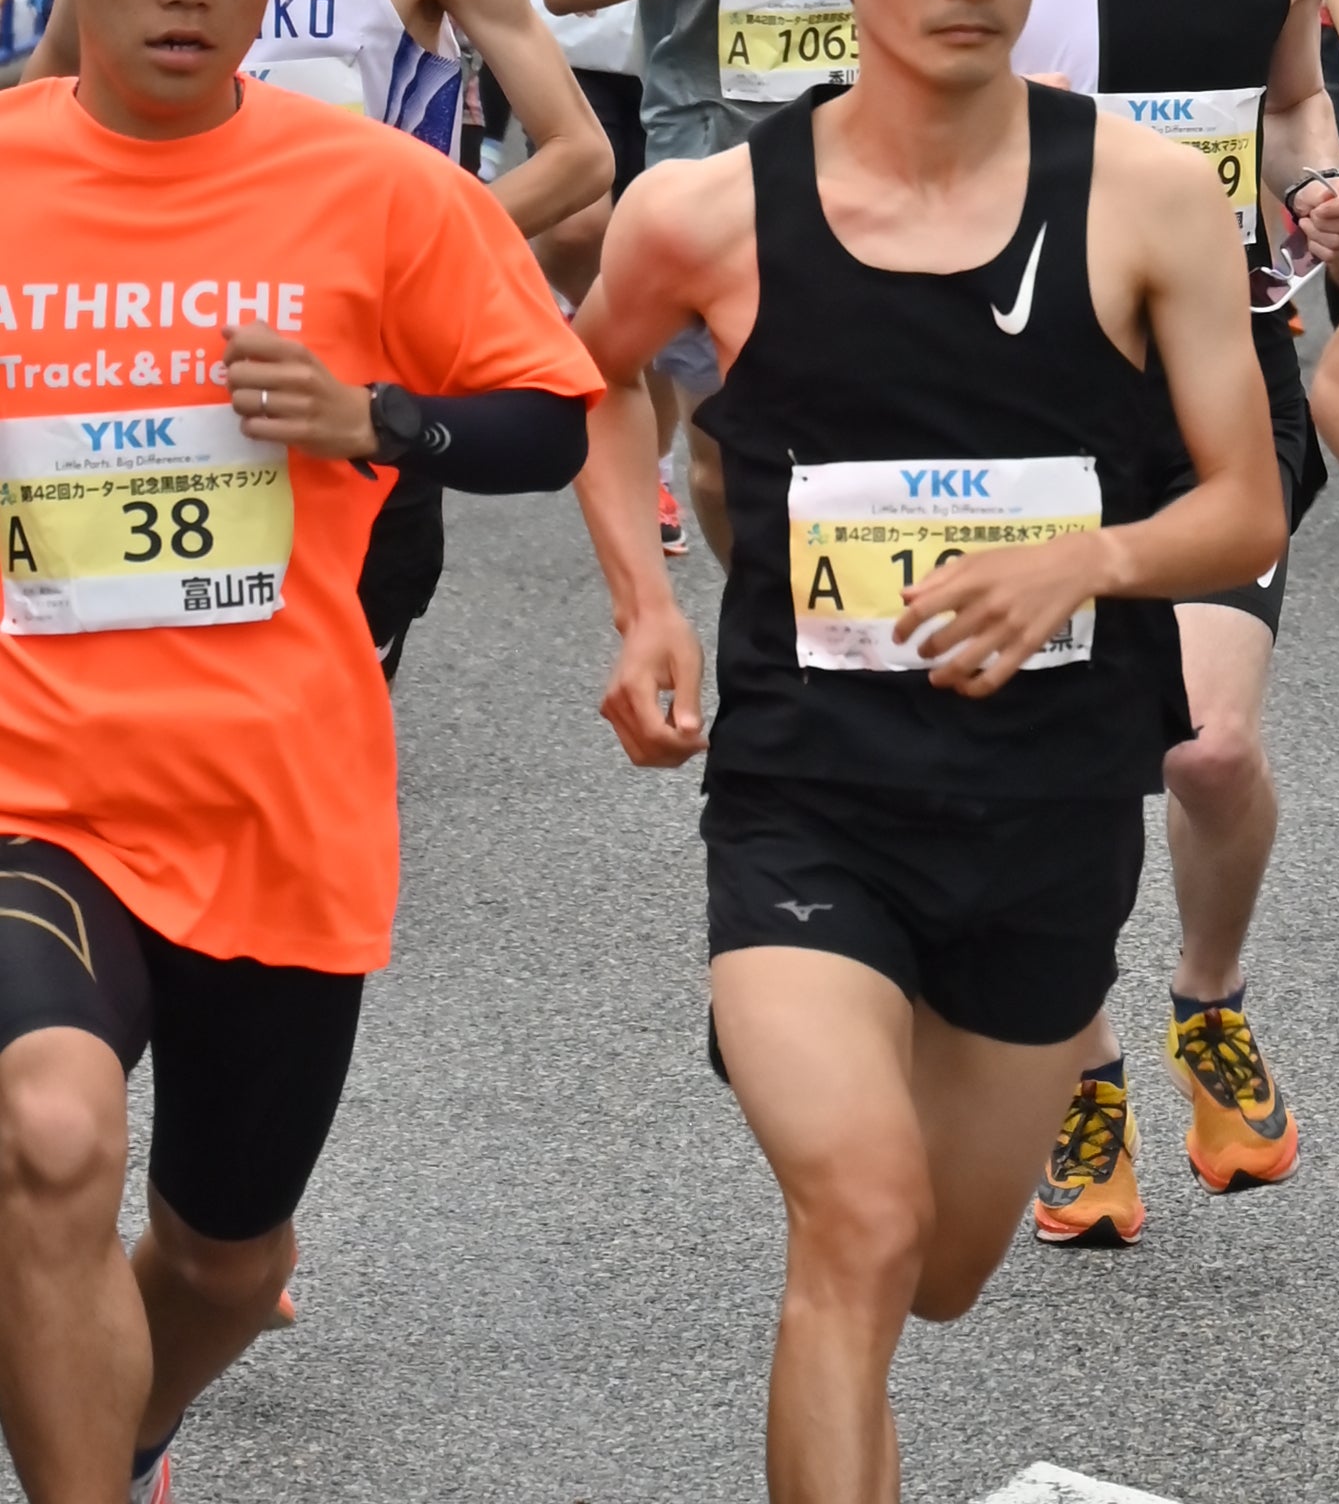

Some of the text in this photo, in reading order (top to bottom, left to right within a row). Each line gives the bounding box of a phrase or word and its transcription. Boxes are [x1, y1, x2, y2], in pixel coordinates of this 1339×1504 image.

[727, 31, 751, 66] A
[1127, 98, 1195, 122] YKK
[1217, 154, 1241, 198] 9
[80, 416, 178, 452] YKK
[116, 456, 134, 471] Big
[20, 469, 279, 504] 第42回カーター記念黒部名水マラソン
[899, 469, 991, 499] YKK
[7, 496, 215, 573] A 38
[181, 572, 277, 613] 富山市
[807, 555, 845, 611] A
